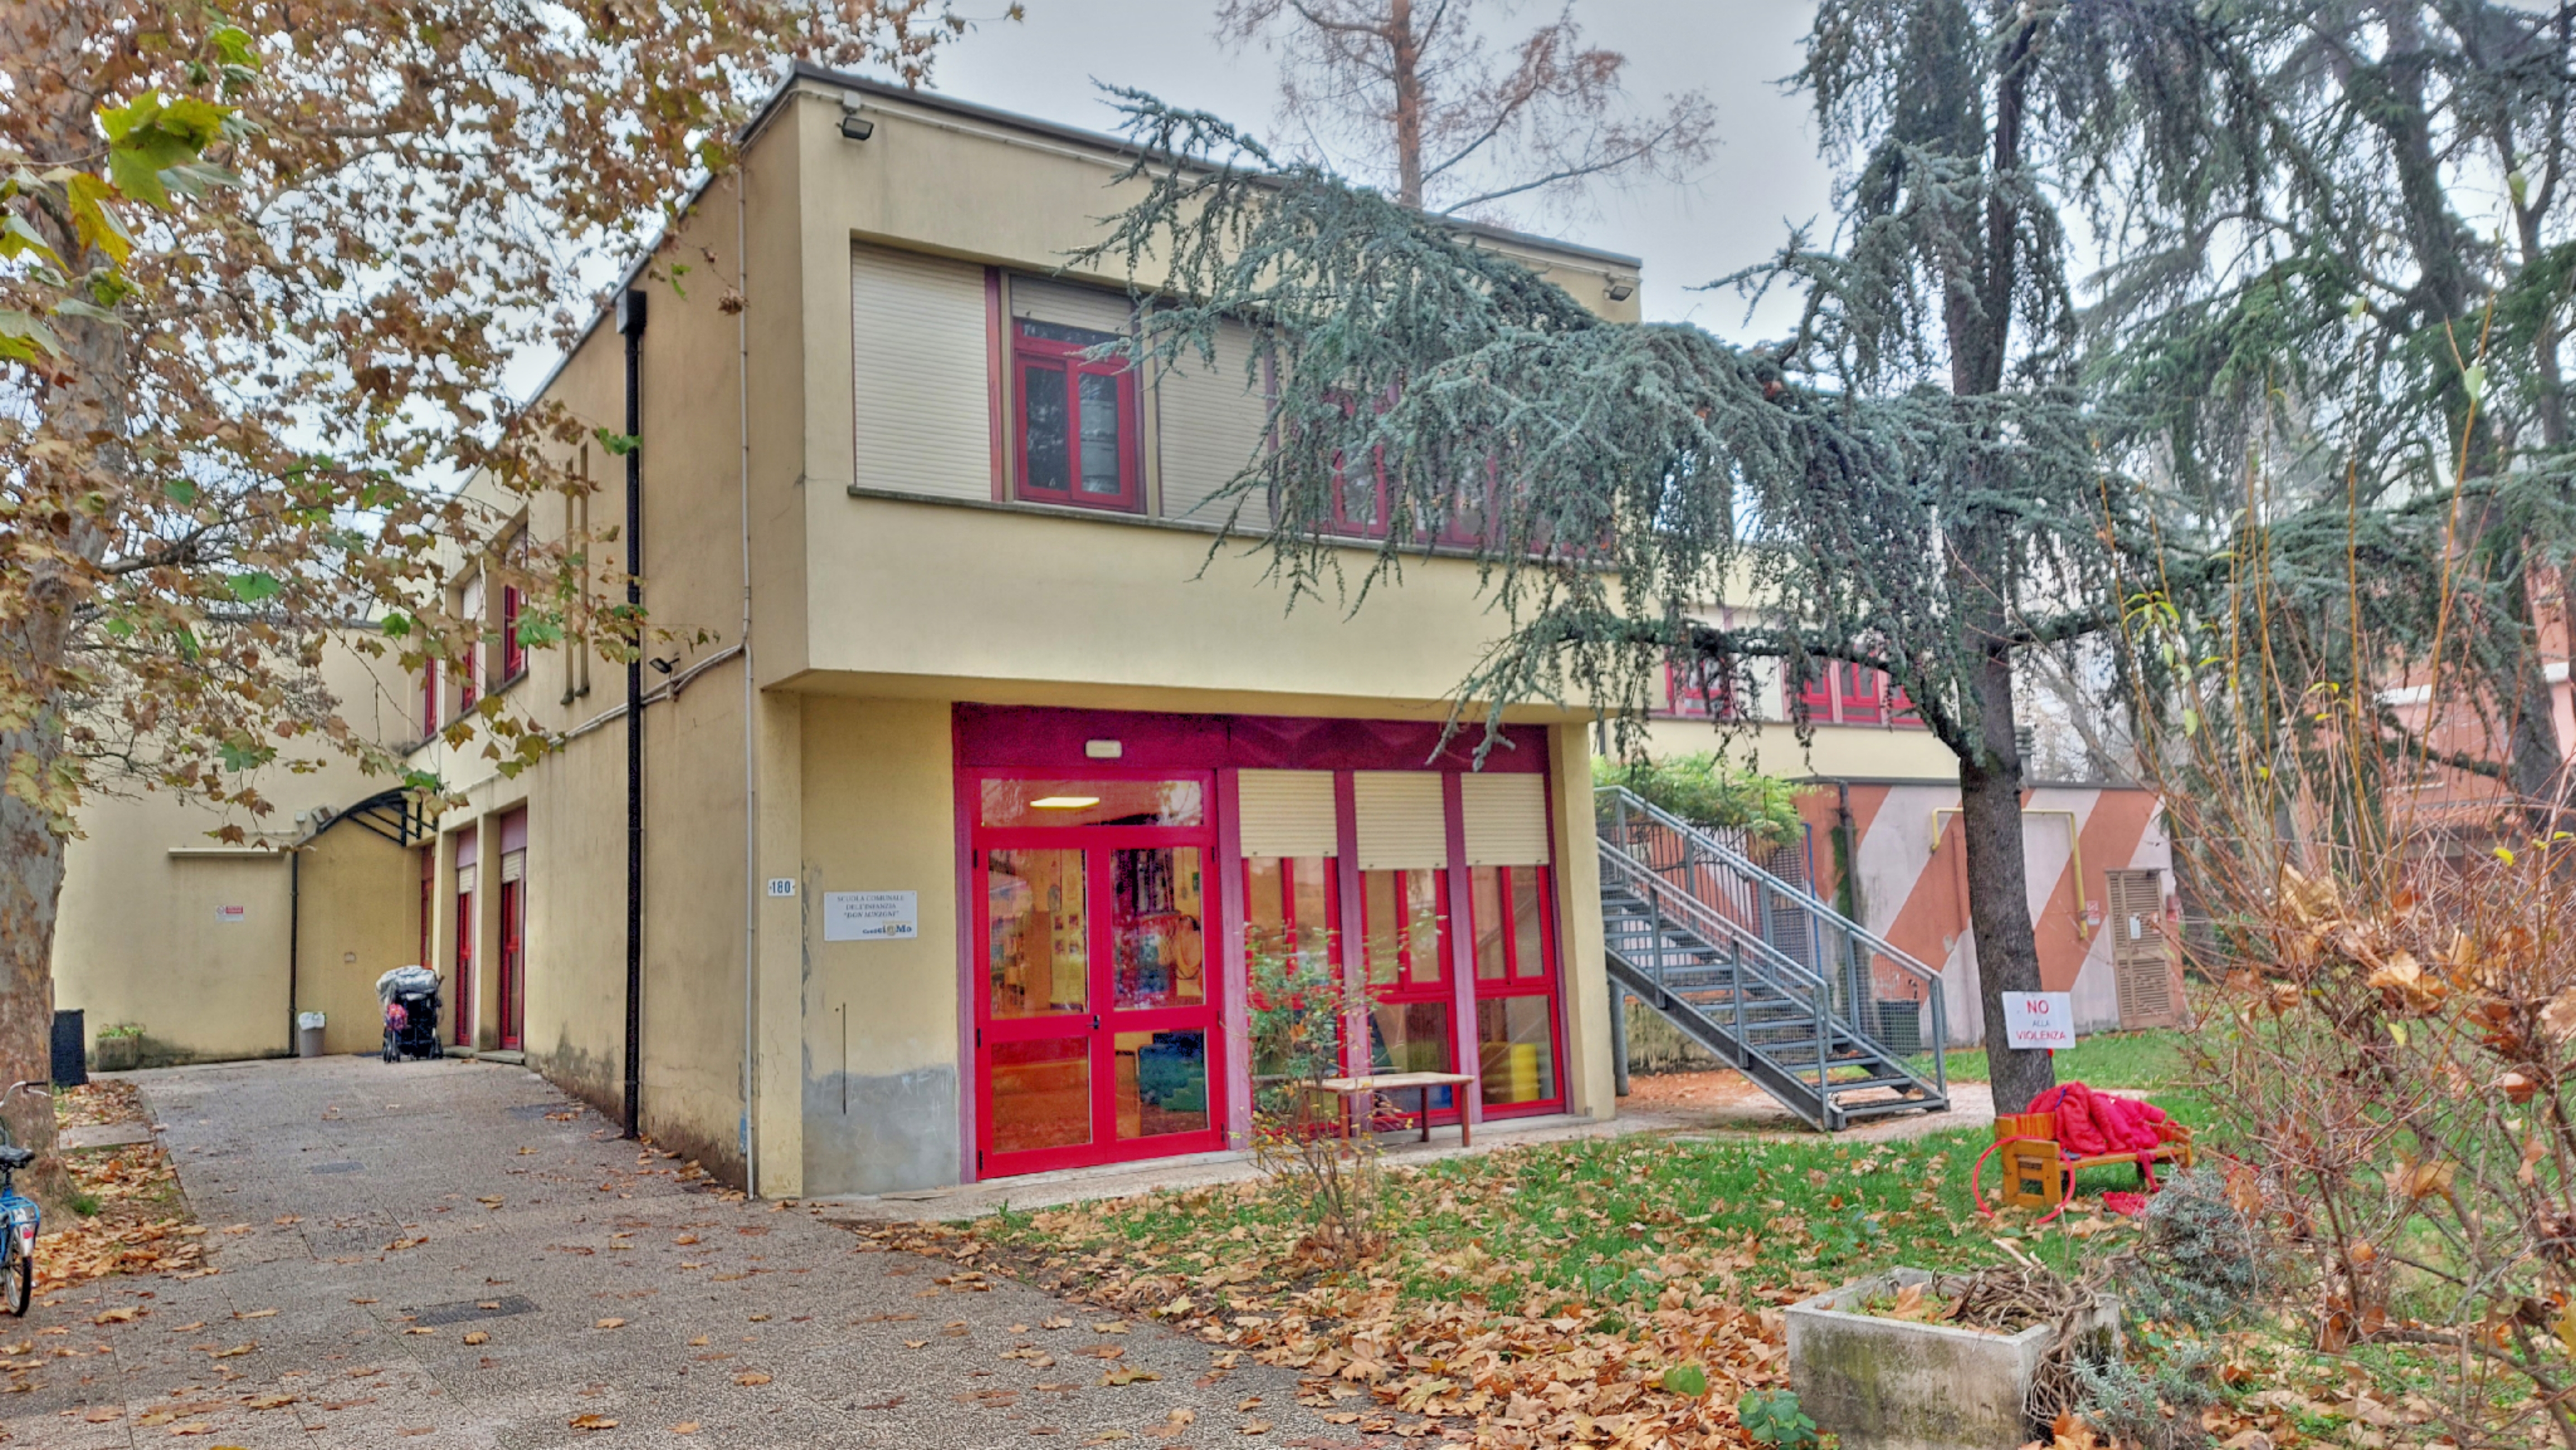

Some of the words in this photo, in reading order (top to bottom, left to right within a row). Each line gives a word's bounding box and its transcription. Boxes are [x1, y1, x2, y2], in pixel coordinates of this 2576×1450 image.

[772, 880, 791, 894] 180
[2026, 999, 2049, 1014] NO
[2016, 1030, 2066, 1040] VIOLENZA
